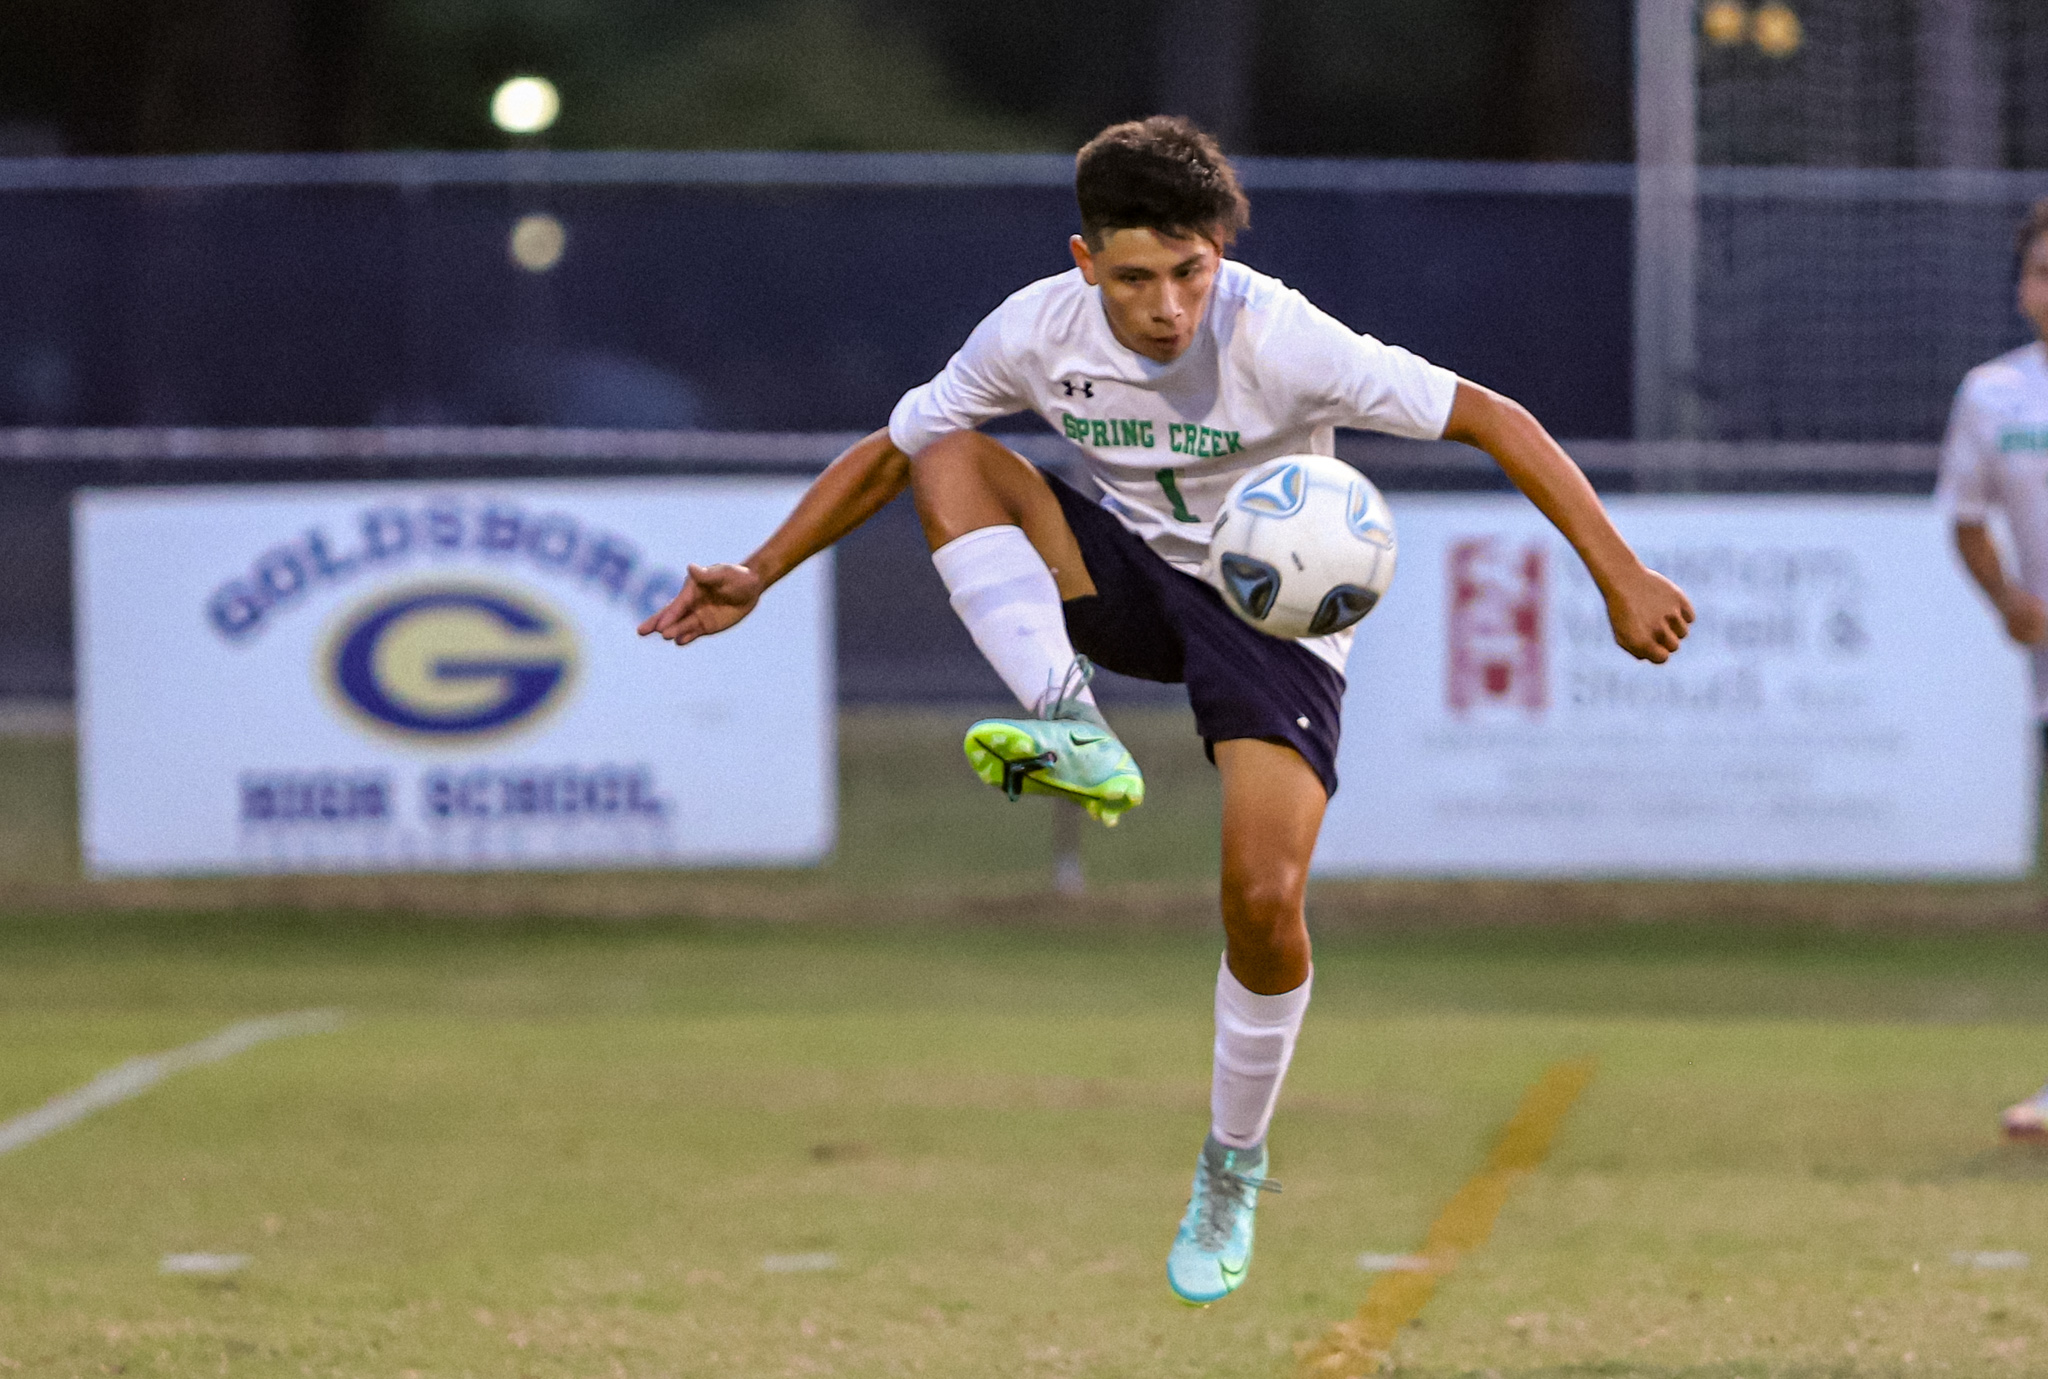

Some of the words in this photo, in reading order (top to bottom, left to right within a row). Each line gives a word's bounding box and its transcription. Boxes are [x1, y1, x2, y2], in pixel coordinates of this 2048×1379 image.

[1062, 413, 1155, 447] SPRING
[1168, 422, 1245, 457] CREEK
[1155, 467, 1201, 523] 1
[239, 769, 391, 821] HIGH
[423, 765, 672, 820] SCHOOL
